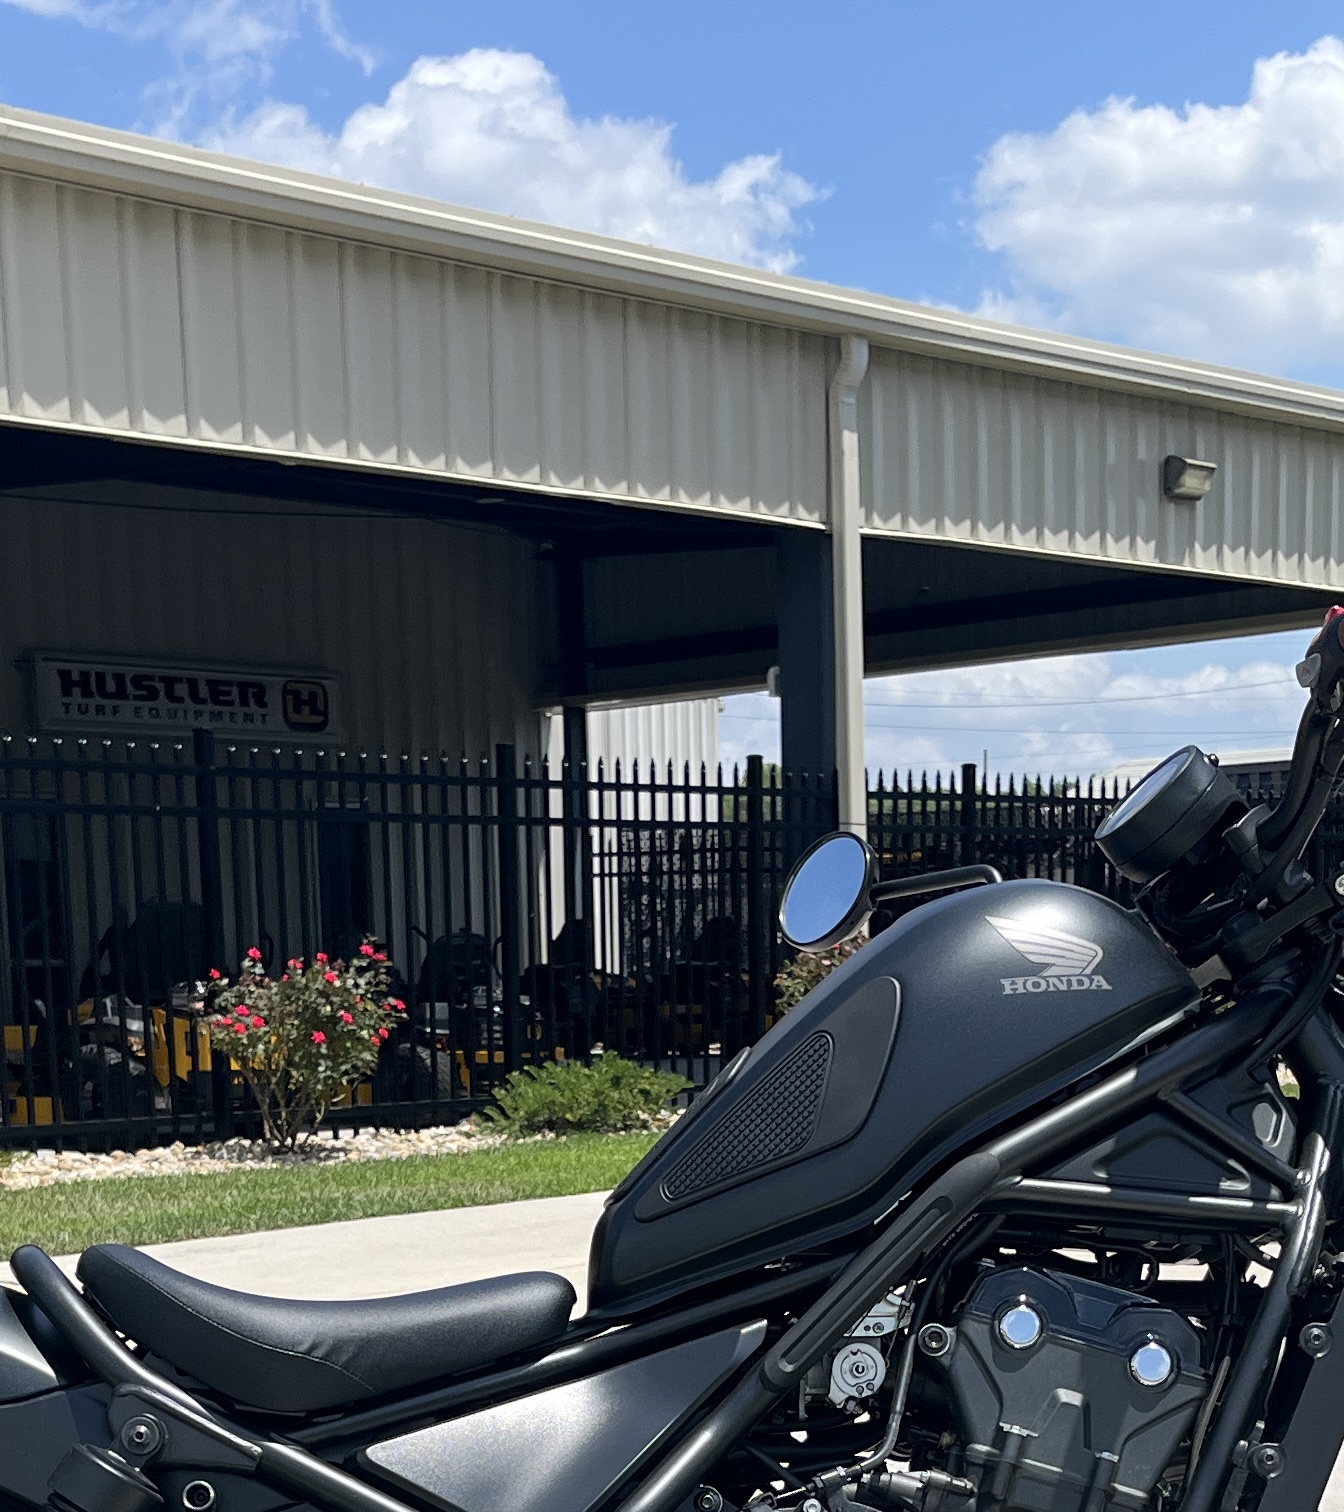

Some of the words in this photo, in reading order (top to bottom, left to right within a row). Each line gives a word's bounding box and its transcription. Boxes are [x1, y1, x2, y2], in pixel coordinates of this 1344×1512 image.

[57, 668, 269, 709] HUSTLER
[61, 702, 121, 718] TURF
[133, 705, 269, 726] EQUIPMENT
[999, 974, 1112, 996] HONDA
